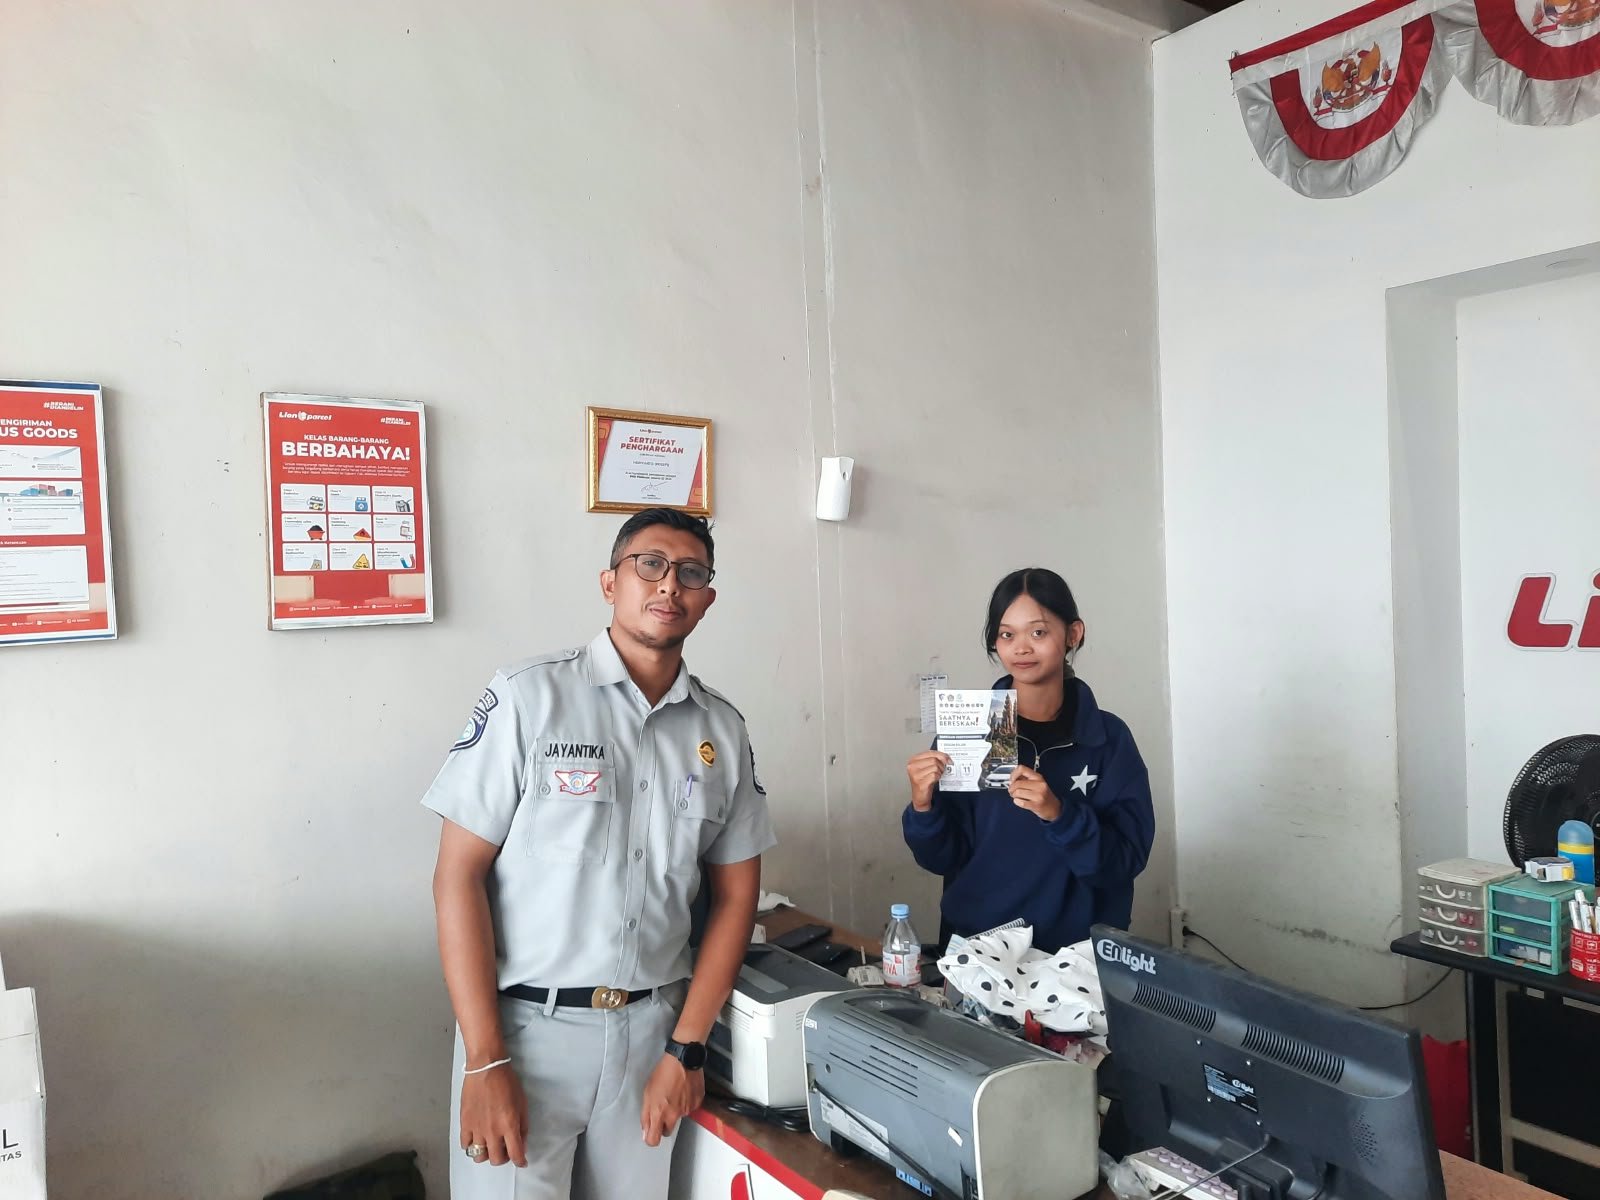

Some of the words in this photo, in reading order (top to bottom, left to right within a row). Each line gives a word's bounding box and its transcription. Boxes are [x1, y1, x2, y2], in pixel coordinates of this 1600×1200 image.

[279, 411, 298, 419] Lion
[23, 427, 78, 439] GOODS
[303, 434, 328, 442] KELAS
[329, 436, 389, 444] BARANG-BARANG
[629, 436, 676, 446] SERTIFIKAT
[281, 441, 411, 461] BERBAHAYA!
[620, 443, 684, 453] PENGHARGAAN
[544, 743, 605, 760] JAYANTIKA
